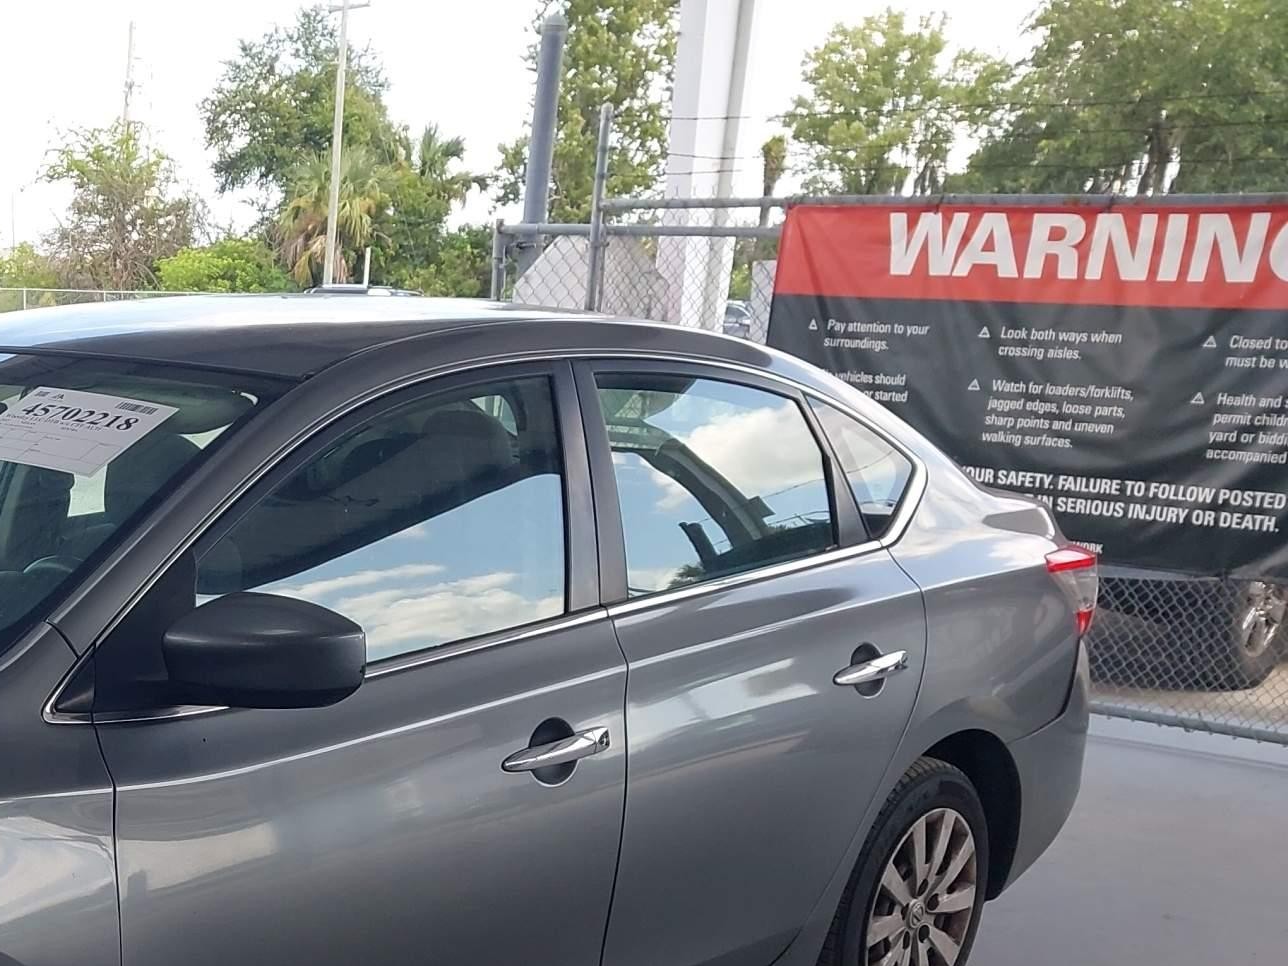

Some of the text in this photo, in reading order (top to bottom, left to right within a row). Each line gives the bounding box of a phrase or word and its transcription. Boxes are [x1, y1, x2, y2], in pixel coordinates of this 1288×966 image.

[827, 319, 931, 337] Pay attention to your
[1001, 326, 1123, 345] Look both ways when
[823, 337, 890, 352] surroundings.
[1229, 335, 1273, 350] Closed
[998, 345, 1082, 360] crossing aisles.
[1225, 356, 1257, 369] must
[1260, 355, 1276, 369] be
[874, 373, 907, 386] should
[874, 391, 908, 402] started
[992, 379, 1134, 402] Watch for loaders/forklifts,
[987, 396, 1126, 419] jagged edges, loose parts,
[1216, 392, 1256, 407] Health
[1258, 396, 1283, 408] and
[22, 402, 140, 431] 45702218
[985, 414, 1114, 434] sharp points and uneven
[1212, 412, 1251, 426] permit
[982, 431, 1073, 448] walking surfaces.
[1208, 431, 1238, 444] yard
[1240, 434, 1255, 444] or
[1206, 449, 1287, 464] accompanied
[997, 469, 1054, 489] SAFETY.
[1057, 475, 1122, 495] FAILURE
[1124, 480, 1145, 497] TO
[1148, 483, 1216, 504] FOLLOW
[1217, 489, 1287, 509] POSTED
[1057, 497, 1124, 517] SERIOUS
[1127, 503, 1189, 524] INJURY
[1192, 509, 1215, 527] OR
[1218, 511, 1280, 532] DEATH.
